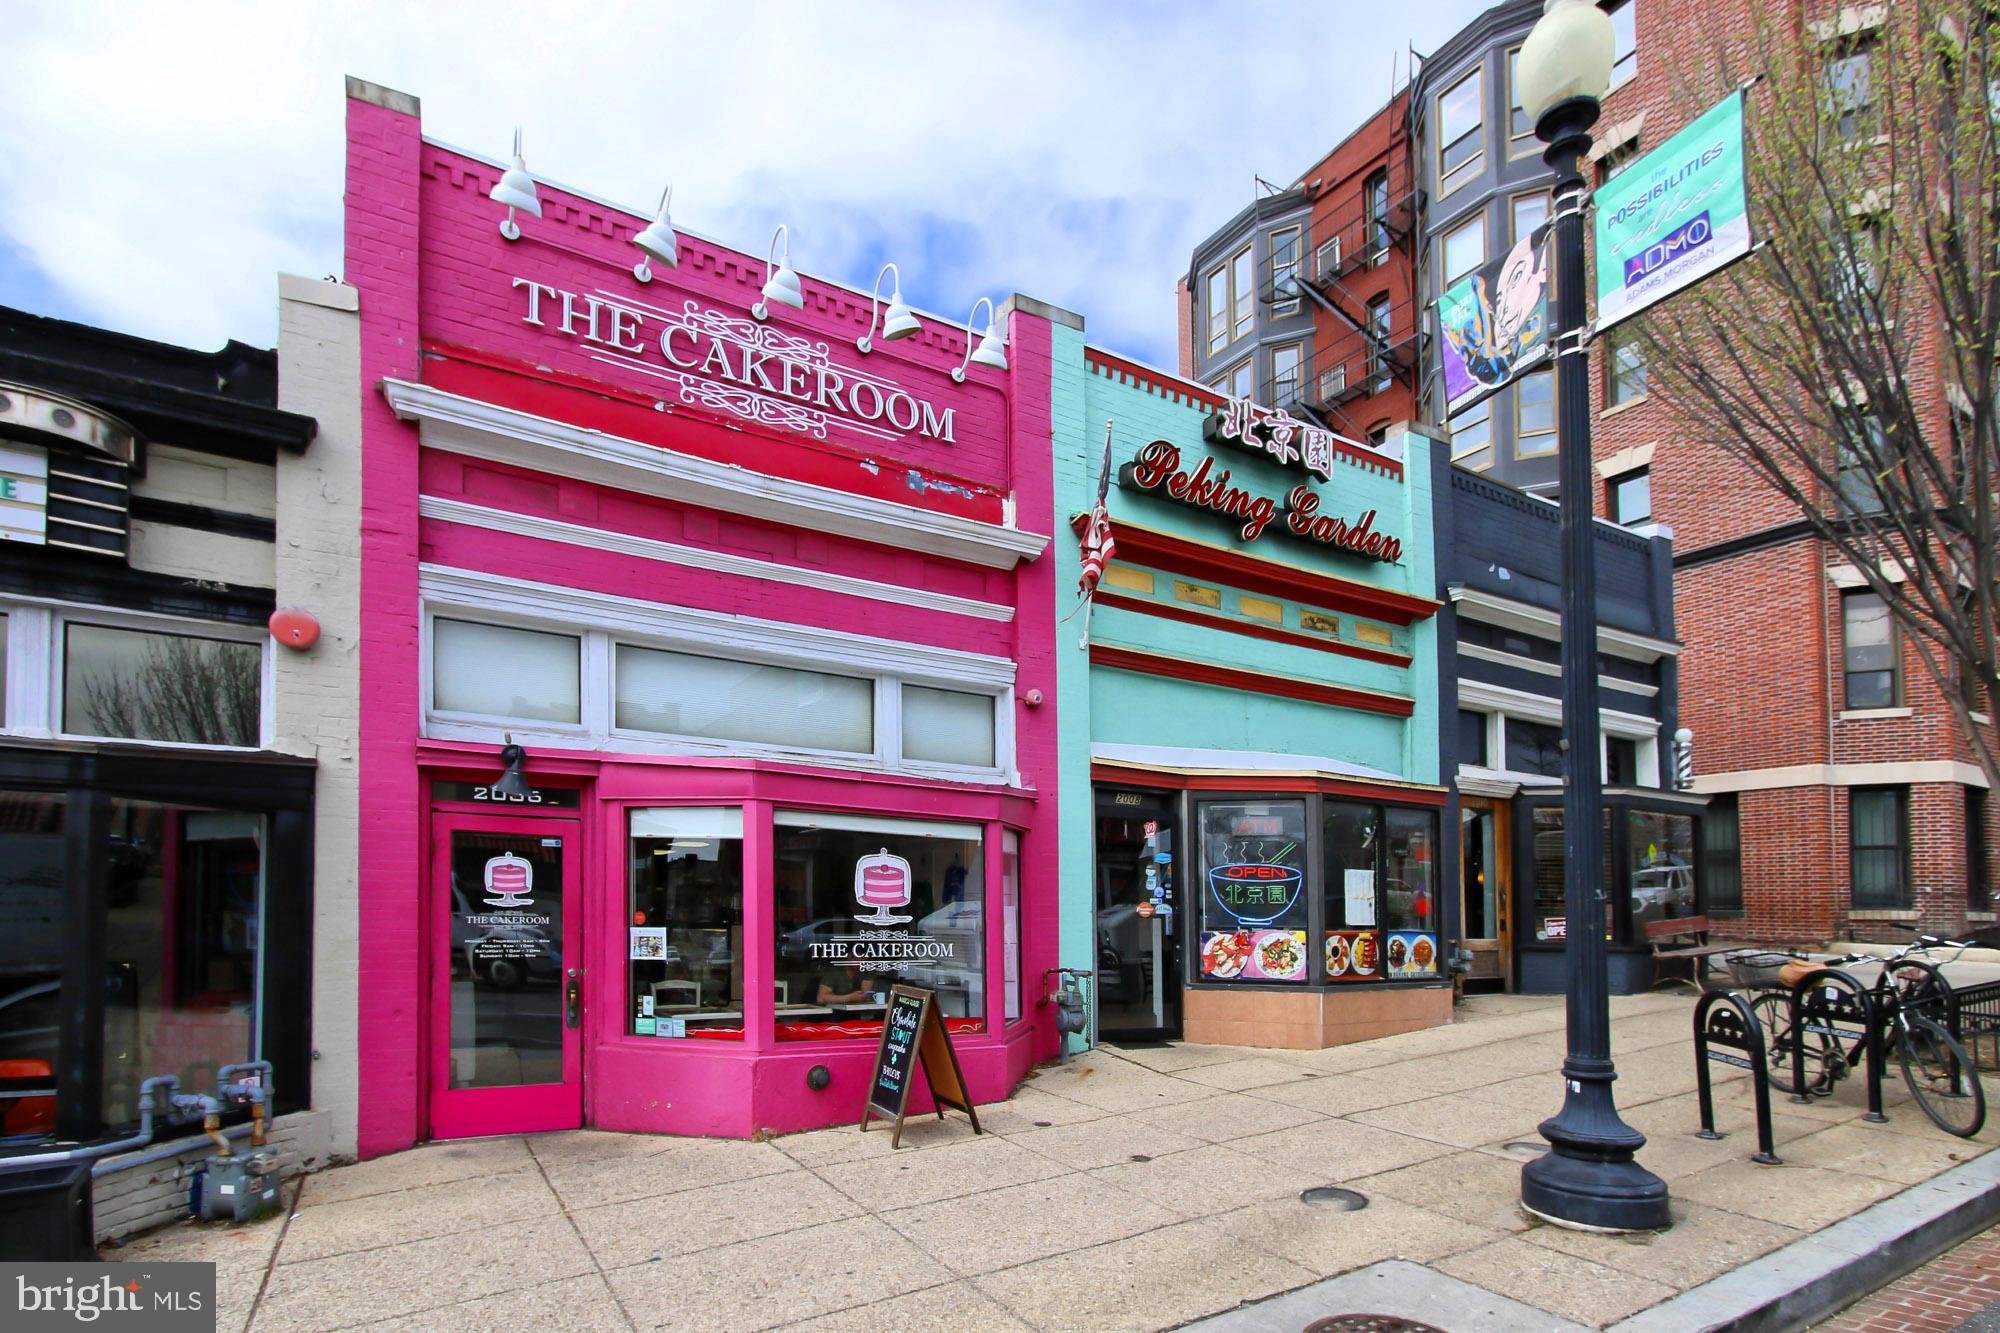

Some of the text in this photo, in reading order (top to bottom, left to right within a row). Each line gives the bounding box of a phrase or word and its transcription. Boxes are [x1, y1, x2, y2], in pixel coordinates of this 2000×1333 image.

[1608, 142, 1723, 229] POSSIBILITIES
[1627, 218, 1709, 284] ADMO
[1626, 246, 1715, 302] ADAMS MORGAN
[512, 276, 957, 443] THE CAKEROOM
[1133, 440, 1403, 562] Peking Garden
[1227, 867, 1286, 878] OPEN
[466, 916, 550, 925] THE CAKEROOM
[1547, 926, 1567, 936] OPE
[808, 942, 954, 958] THE CAKEROOM
[891, 1026, 912, 1044] STOUT
